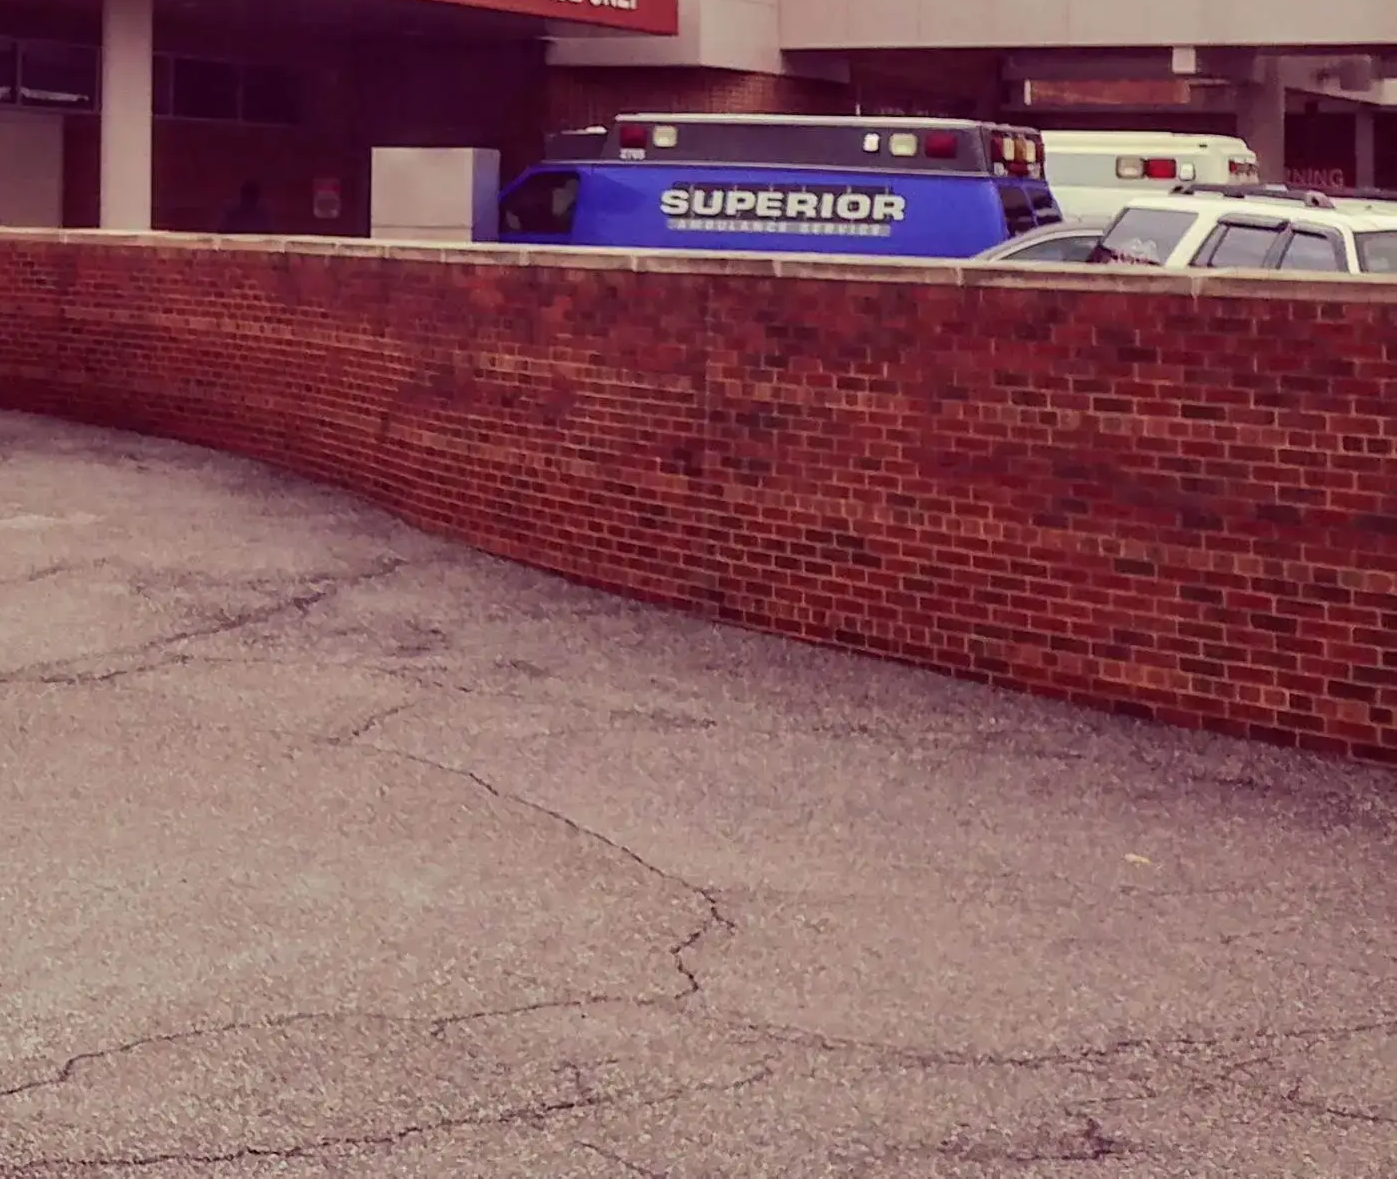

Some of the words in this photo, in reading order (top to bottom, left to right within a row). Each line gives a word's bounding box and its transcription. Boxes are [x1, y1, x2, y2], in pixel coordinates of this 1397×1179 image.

[659, 188, 906, 221] SUPERIOR
[676, 219, 787, 233] AMBULANCE
[798, 222, 881, 236] SERVICE
